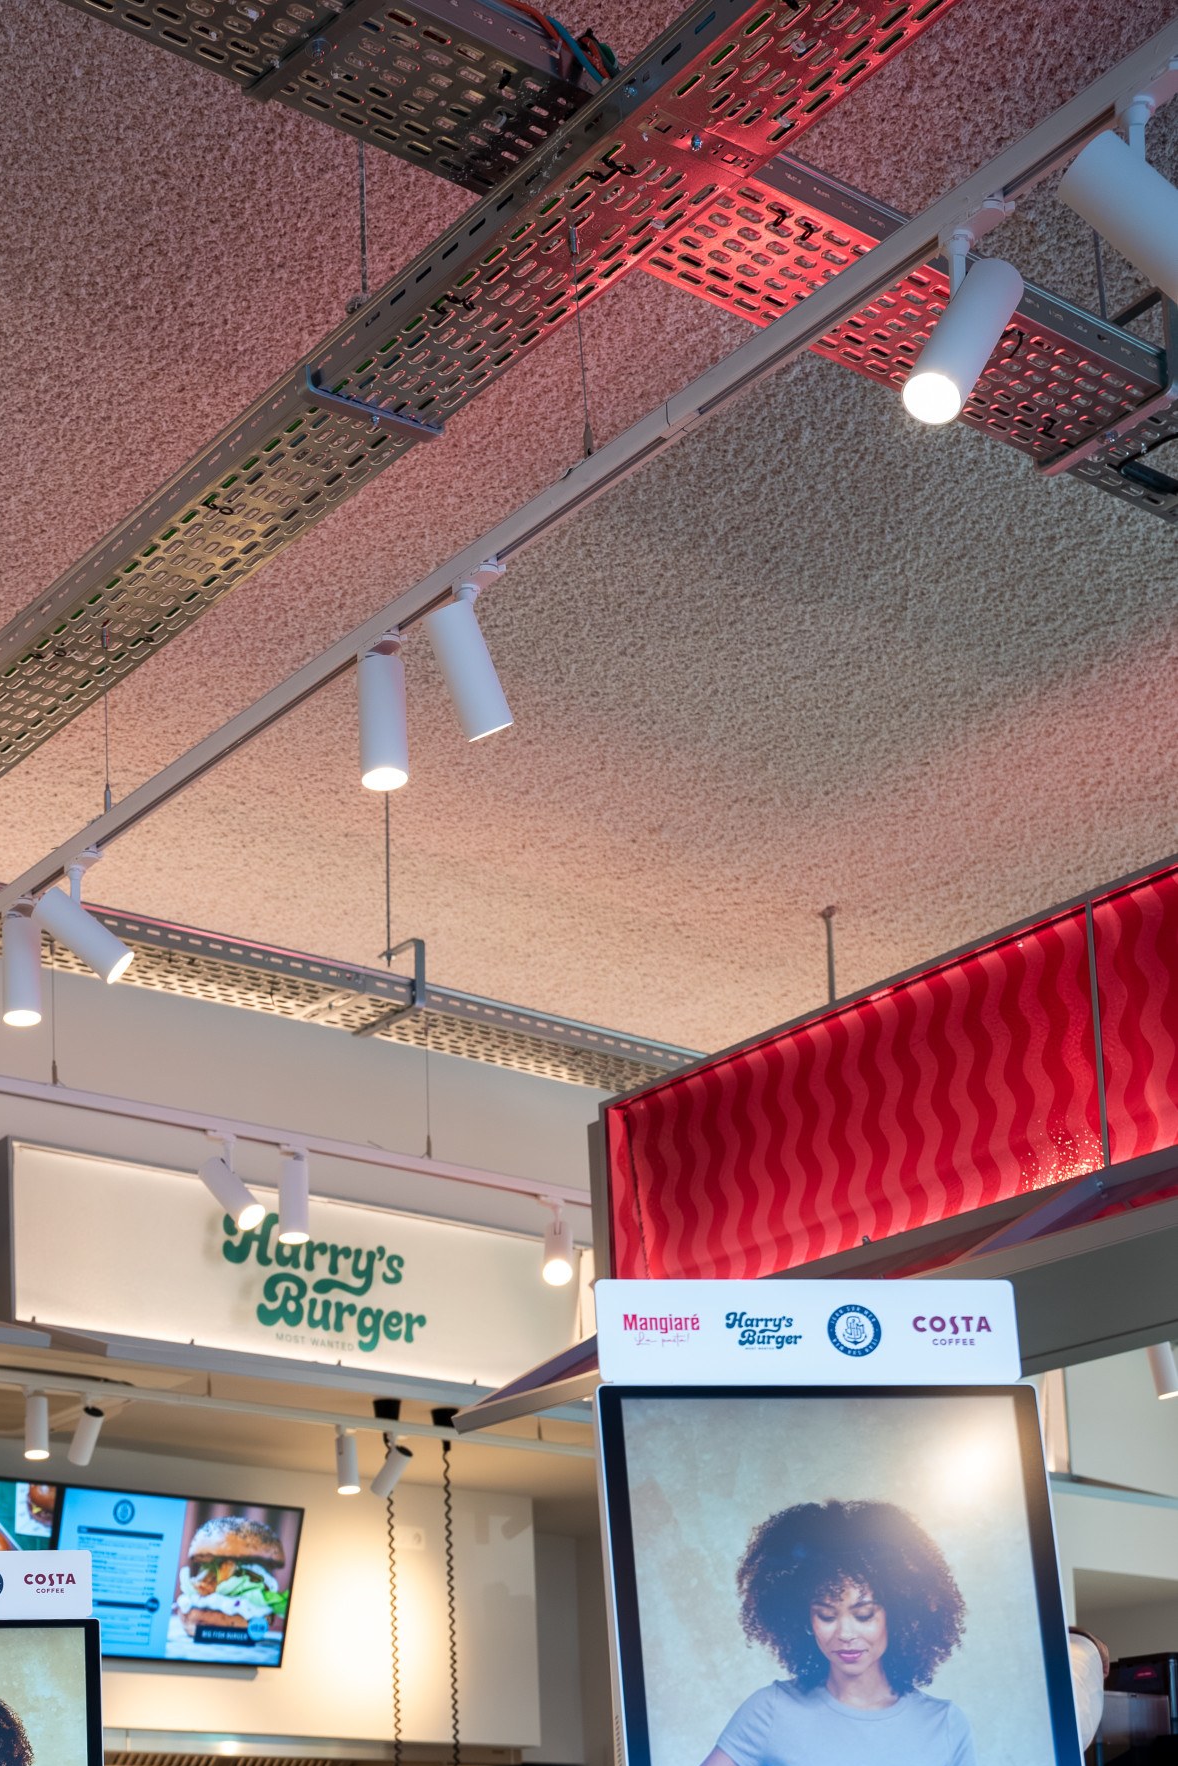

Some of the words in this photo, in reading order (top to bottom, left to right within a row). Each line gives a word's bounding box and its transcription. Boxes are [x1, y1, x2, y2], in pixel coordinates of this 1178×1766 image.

[223, 1212, 405, 1297] Harry's
[256, 1272, 427, 1353] Burger
[725, 1311, 794, 1334] Harry's
[623, 1313, 700, 1334] Mangiaré
[912, 1315, 992, 1335] COSTA
[275, 1332, 306, 1345] MOST
[310, 1337, 355, 1352] WANTED
[738, 1329, 803, 1350] Burger
[932, 1338, 975, 1346] COFFEE
[23, 1573, 77, 1587] COSTA
